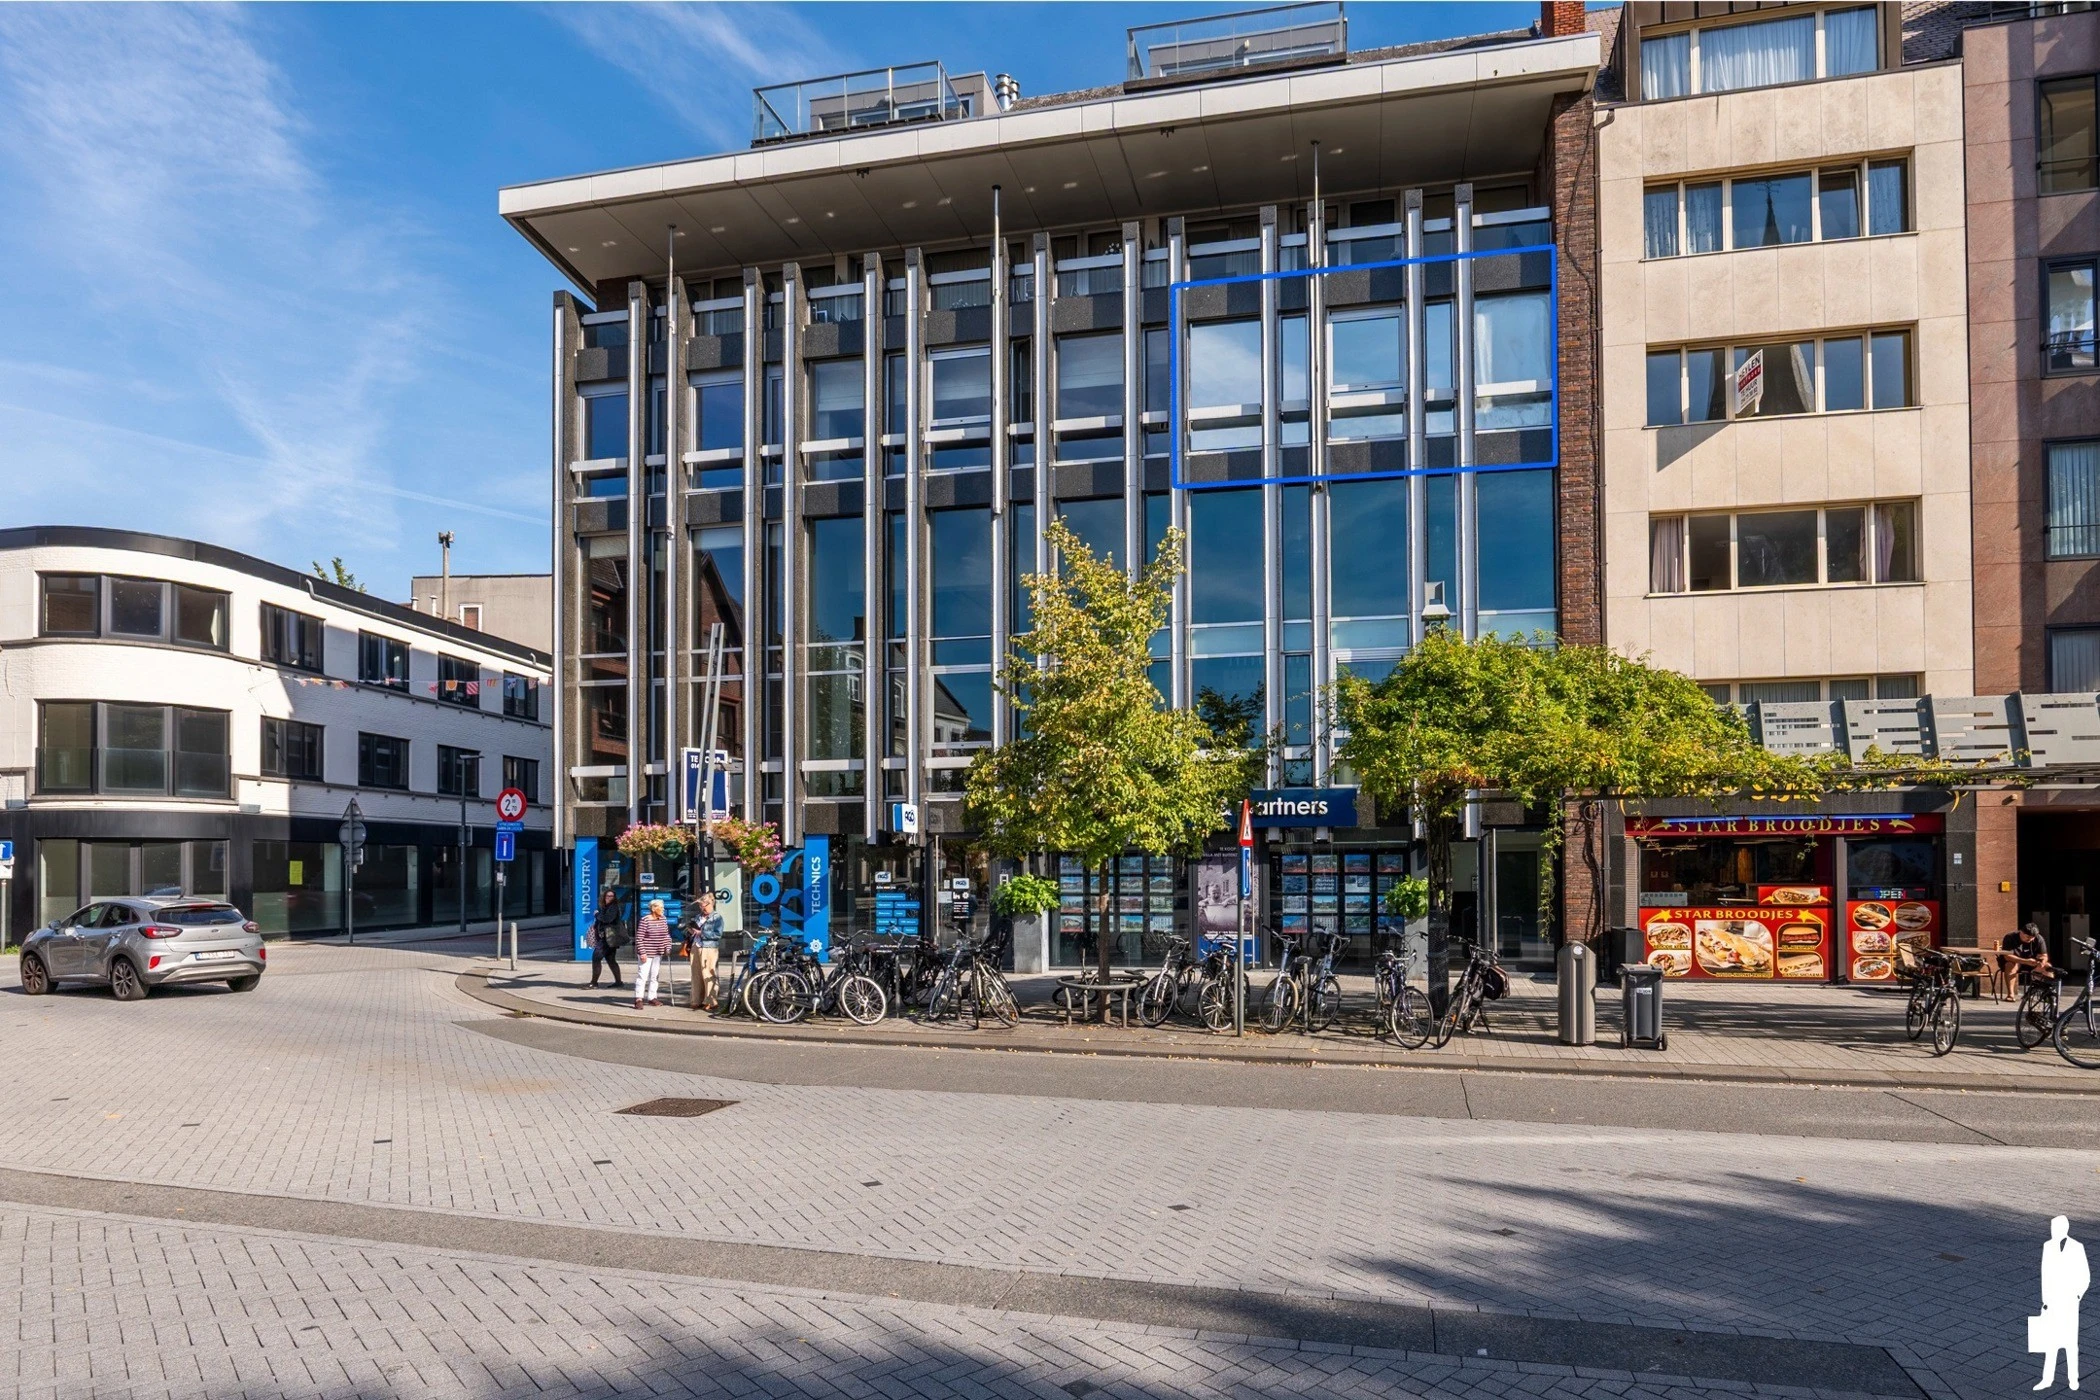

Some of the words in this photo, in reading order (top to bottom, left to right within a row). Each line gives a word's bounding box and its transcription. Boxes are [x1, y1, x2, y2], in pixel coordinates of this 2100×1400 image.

[505, 799, 510, 811] 2
[1239, 797, 1328, 815] artners
[905, 811, 914, 822] AGO
[1678, 821, 1738, 832] STAR
[1748, 819, 1880, 832] BROODJES
[582, 857, 590, 914] INDUSTRY
[812, 856, 821, 915] TECHNICS
[714, 890, 730, 900] GO
[1675, 910, 1711, 918] STAR
[1716, 910, 1794, 920] BROODJES
